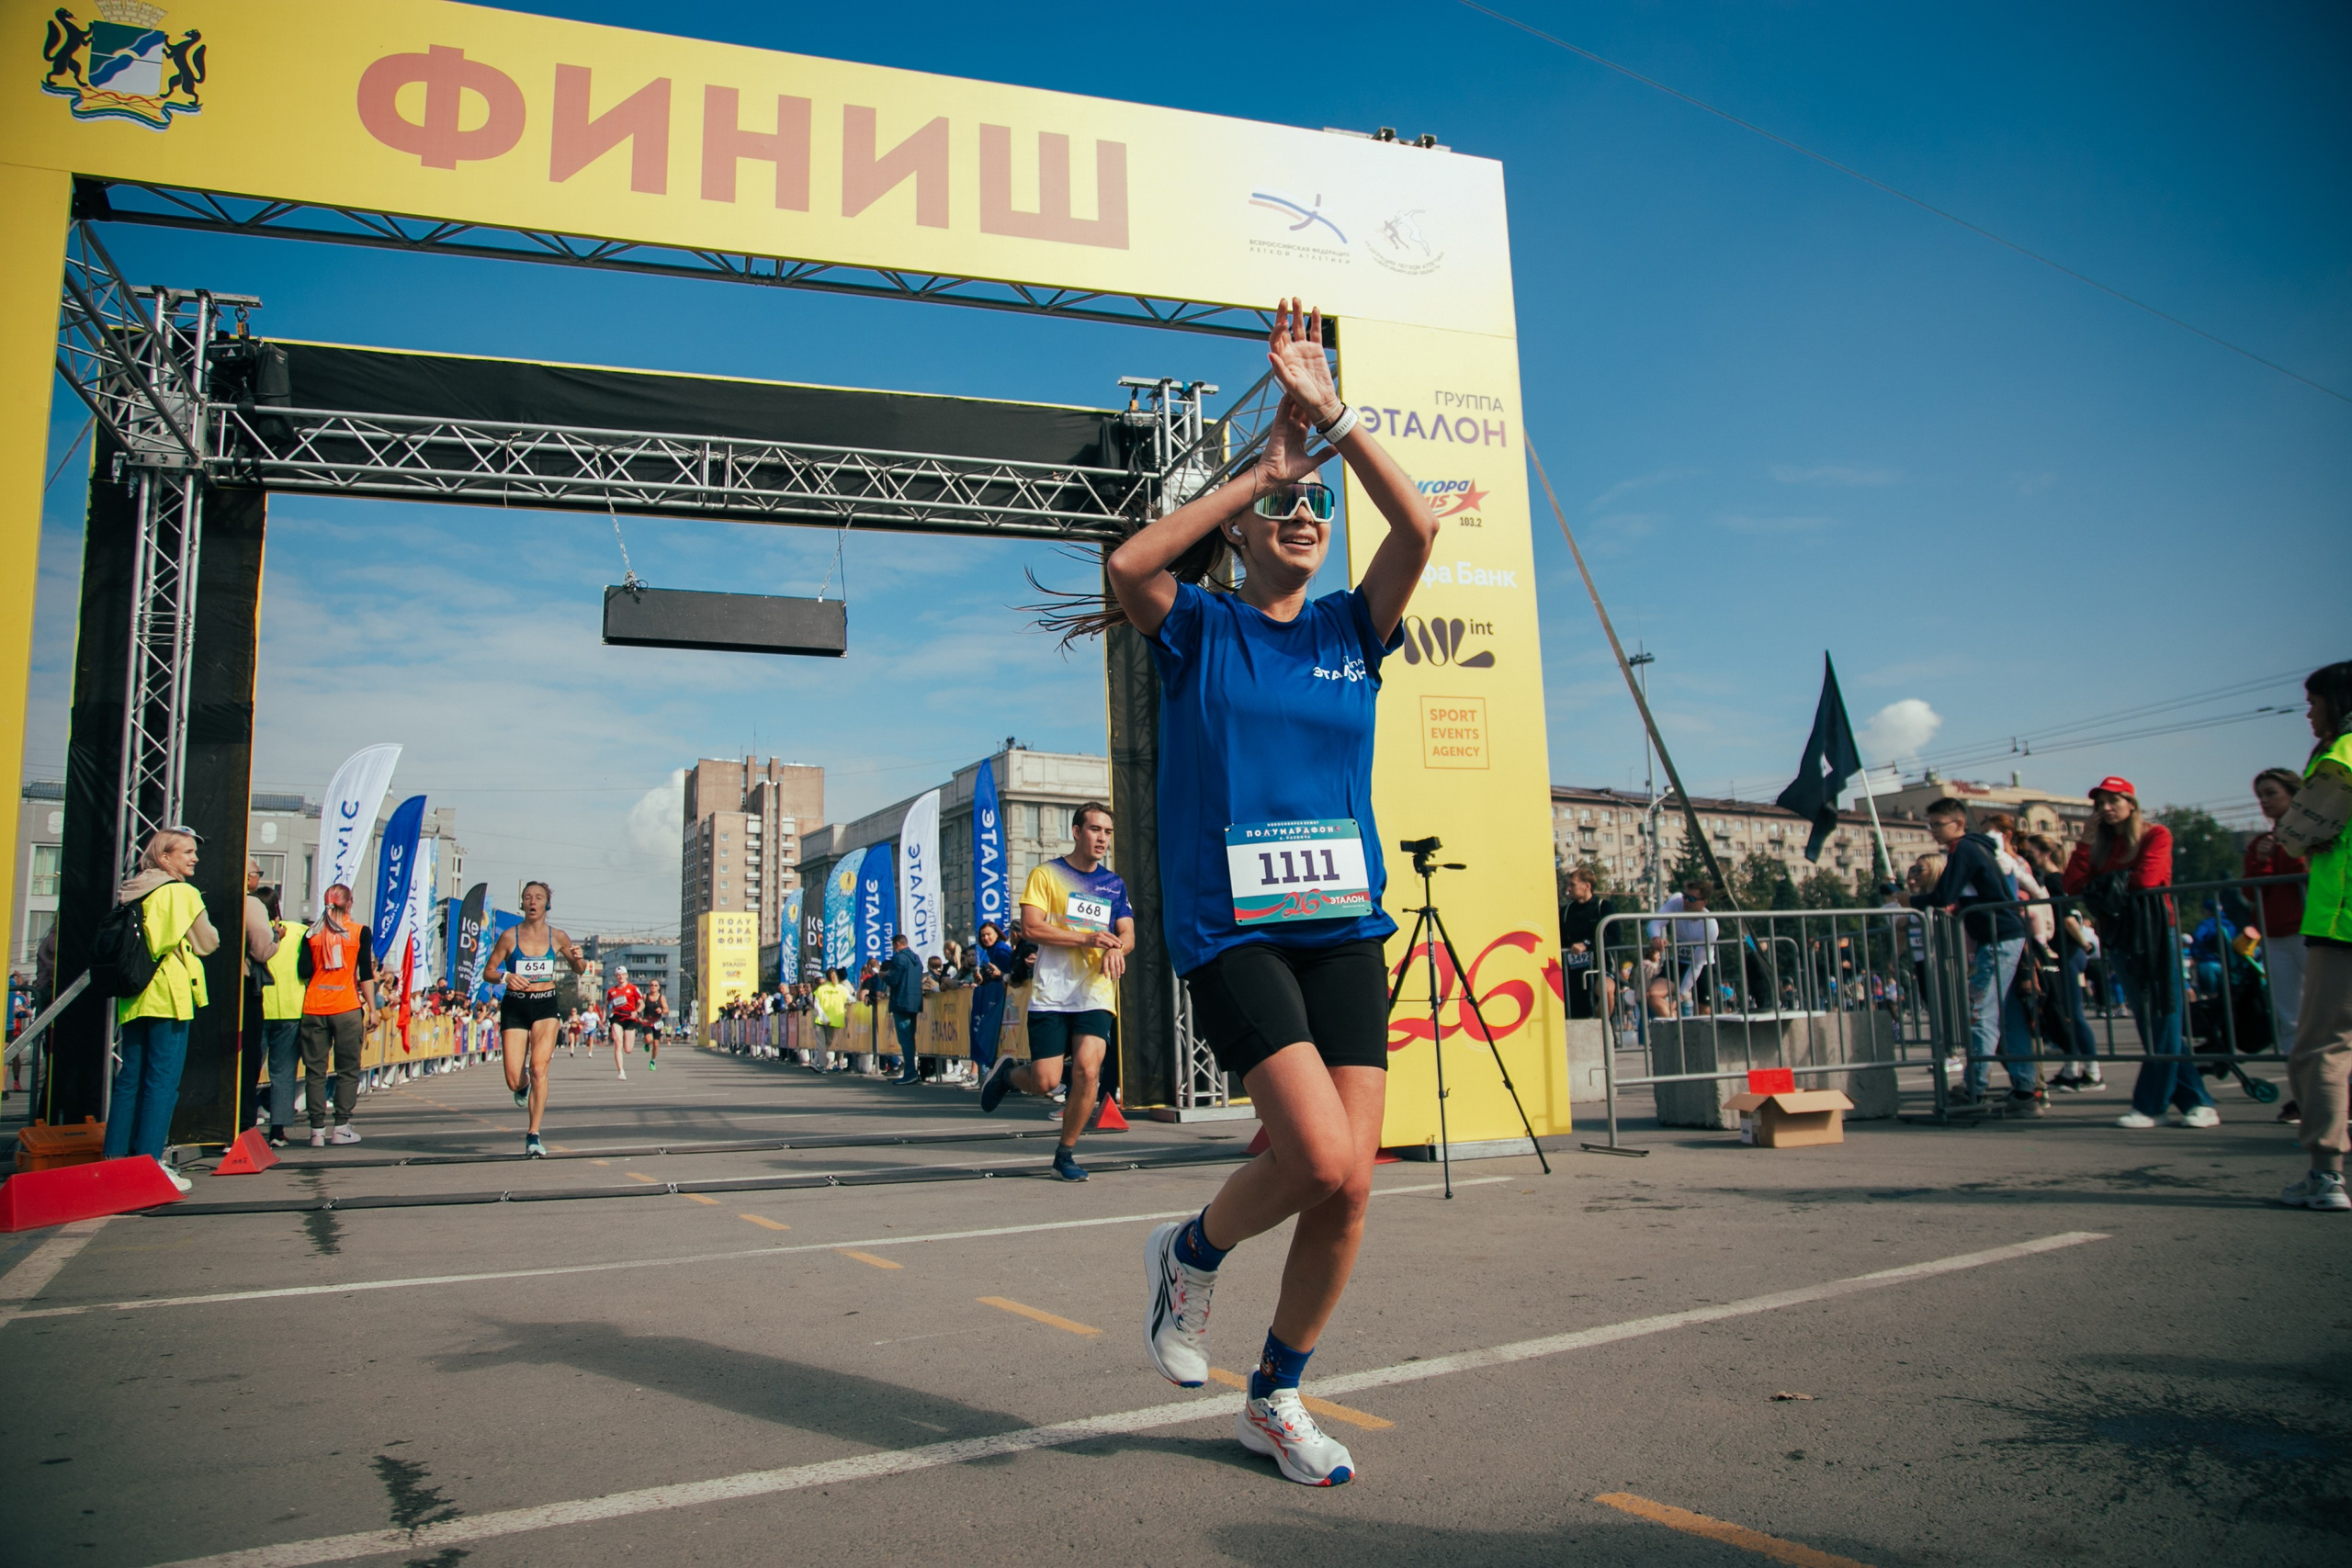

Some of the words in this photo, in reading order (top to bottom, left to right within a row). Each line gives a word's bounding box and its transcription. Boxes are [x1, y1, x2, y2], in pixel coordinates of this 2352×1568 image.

[356, 43, 1130, 251] ФИНИШ
[1249, 239, 1311, 253] ВСЕРОССИЙСКАЯ
[1312, 247, 1351, 258] ФЕДЕРАЦИЯ
[1249, 246, 1291, 257] ЛЕГКОЙ
[1298, 253, 1351, 265] АТЛЕТИКИ
[1435, 390, 1504, 412] ГРУППА
[1358, 405, 1508, 448] ЭТАЛОН
[1459, 516, 1483, 528] 103.2
[1455, 560, 1520, 589] Банк
[1469, 618, 1495, 636] int
[1429, 708, 1478, 723] SPORT
[1430, 727, 1480, 740] EVENTS
[1431, 745, 1481, 758] AGENCY
[1246, 826, 1334, 838] ПОЛУМАРАФОН
[1258, 849, 1340, 886] 1111
[908, 843, 928, 948] ЭТАЛОН
[1283, 888, 1321, 918] 26
[1329, 895, 1365, 905] ЭТАЛОН
[1077, 902, 1102, 917] 668
[883, 922, 893, 961] ГРУПП
[525, 962, 546, 971] 654
[506, 990, 526, 999] PRO
[529, 990, 553, 1000] NIKE
[1387, 931, 1544, 1052] 26
